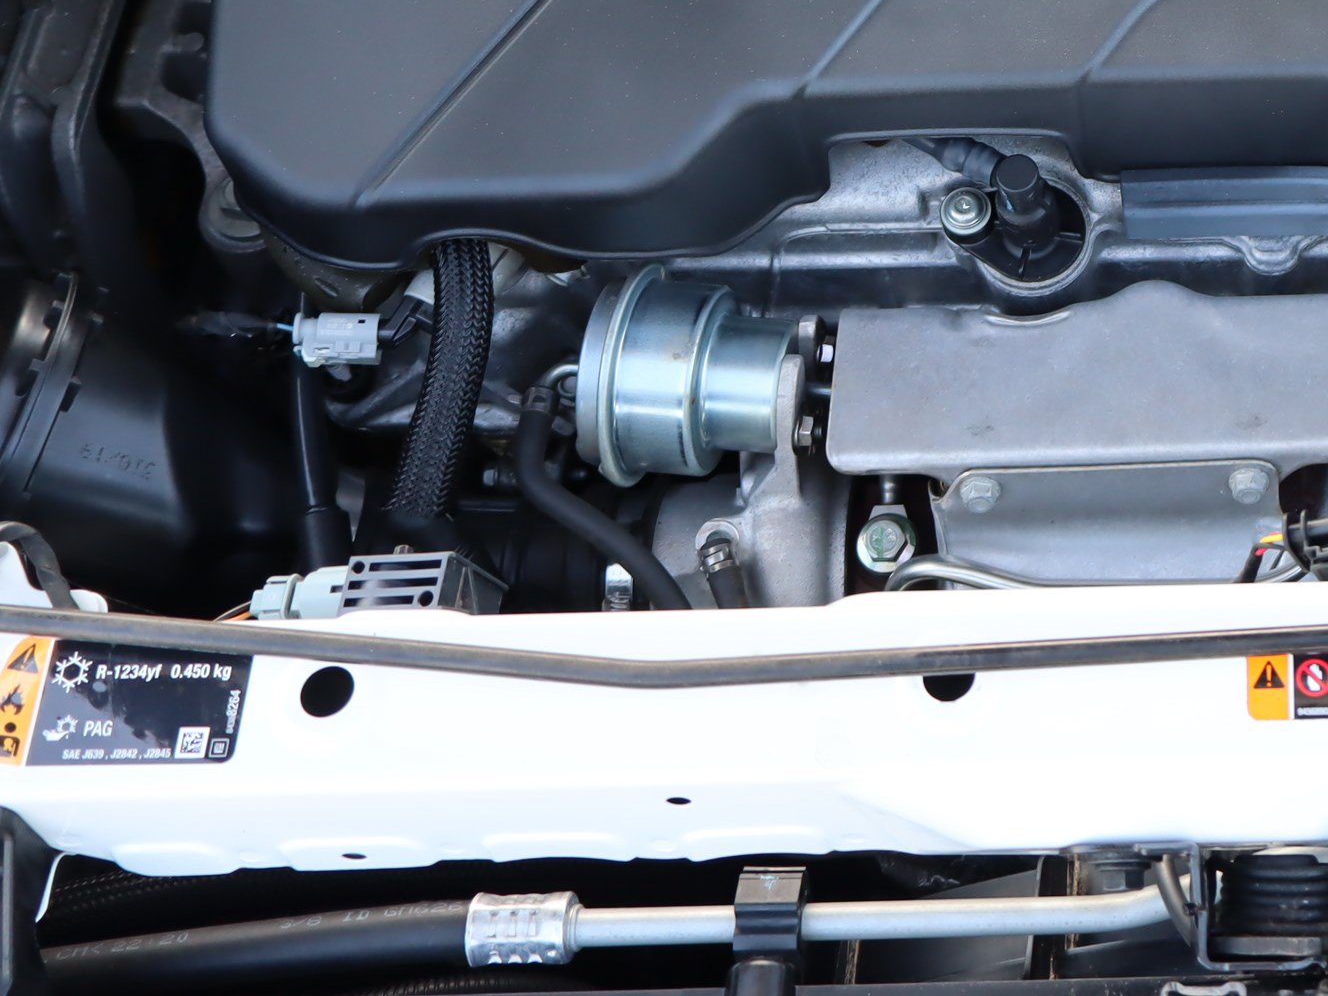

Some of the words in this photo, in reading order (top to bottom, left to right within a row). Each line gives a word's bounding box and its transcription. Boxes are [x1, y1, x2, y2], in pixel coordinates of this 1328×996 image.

[96, 663, 162, 682] R-1234yf
[170, 663, 210, 679] 0.450
[213, 663, 232, 682] kg
[83, 720, 113, 737] PAG
[62, 748, 81, 760] SAE
